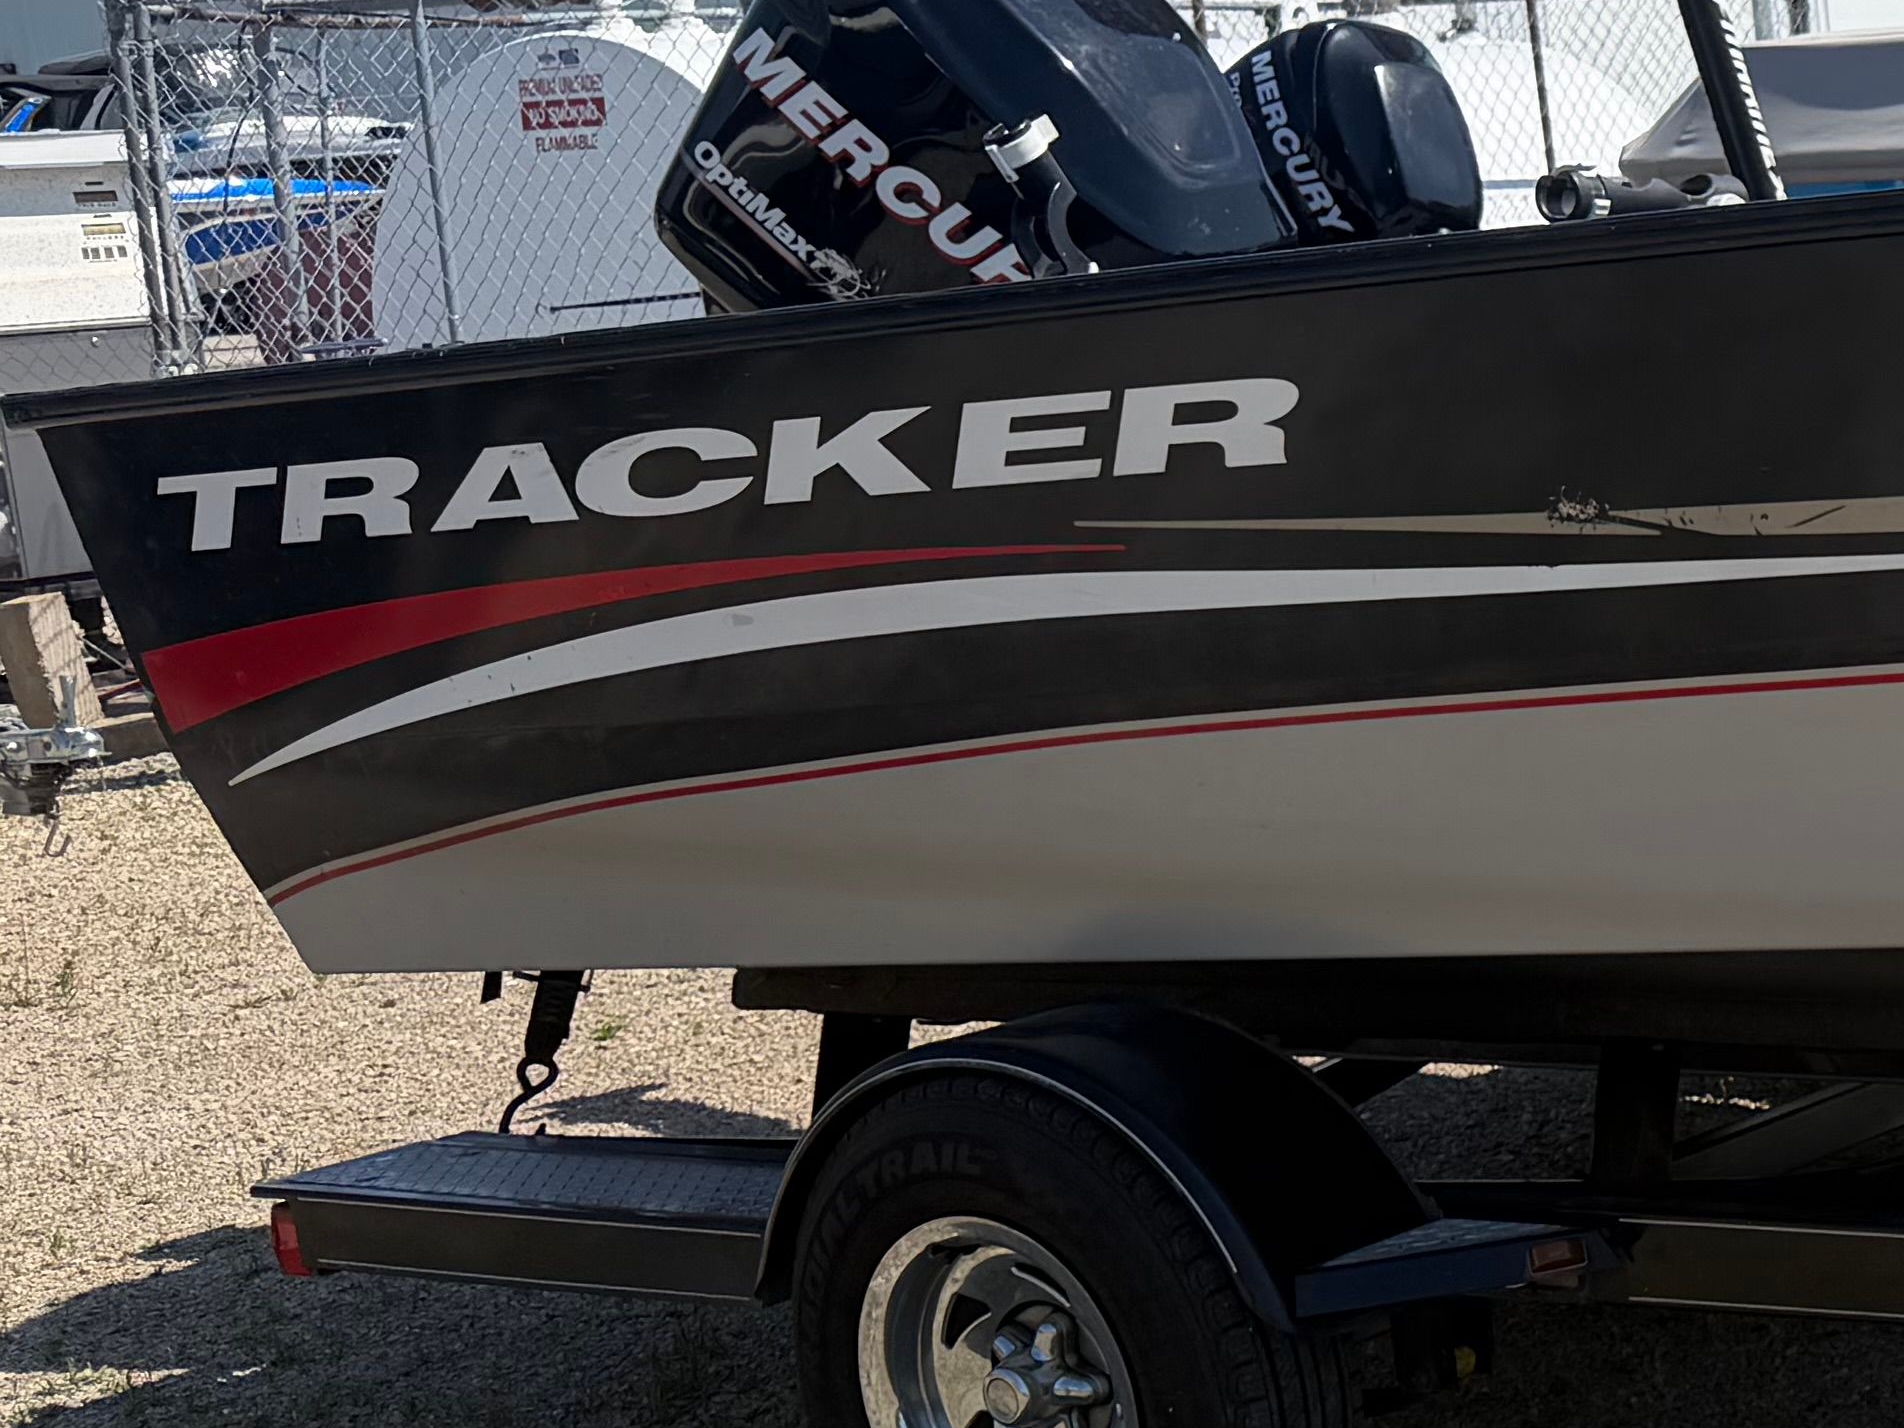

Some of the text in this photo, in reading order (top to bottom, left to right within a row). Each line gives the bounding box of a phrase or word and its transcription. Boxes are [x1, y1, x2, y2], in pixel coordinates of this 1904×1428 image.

[694, 140, 817, 262] OptiMax
[1251, 50, 1355, 232] MERCURY
[156, 377, 1302, 552] TRACKER
